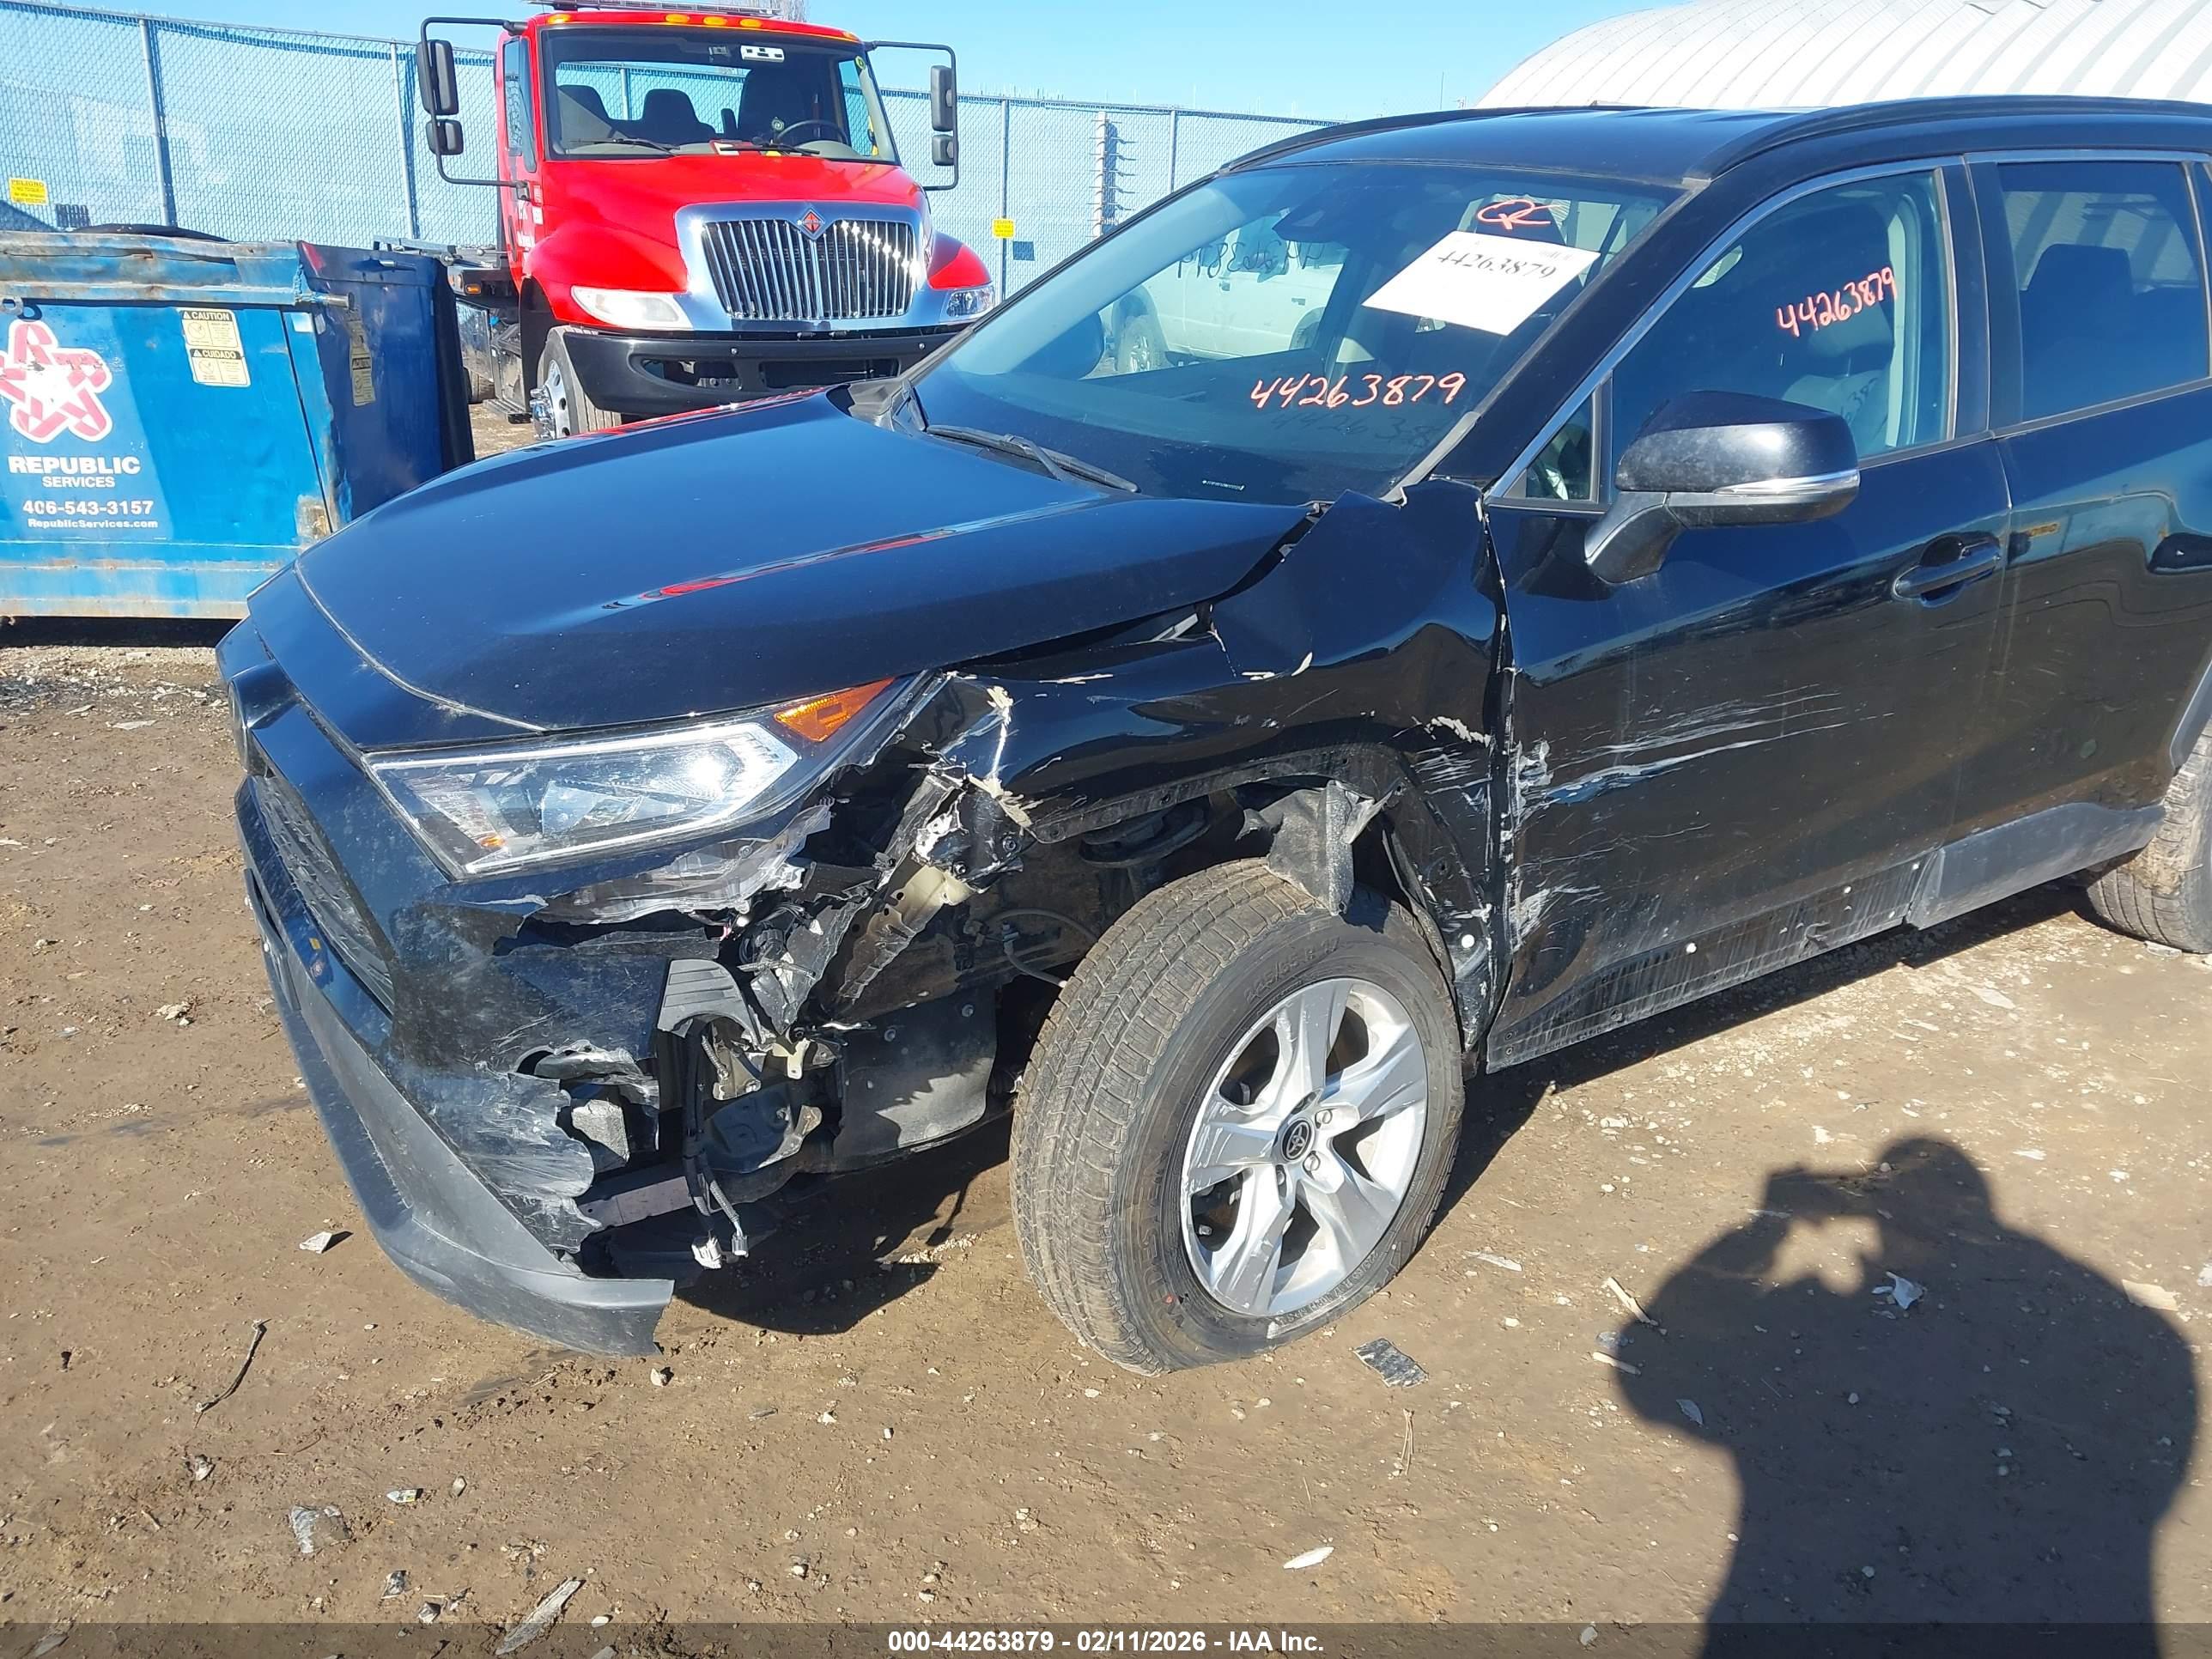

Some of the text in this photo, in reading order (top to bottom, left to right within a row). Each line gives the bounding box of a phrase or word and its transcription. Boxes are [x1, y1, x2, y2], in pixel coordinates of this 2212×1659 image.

[1436, 250, 1558, 279] 44263879
[1777, 267, 1898, 337] 44263879
[191, 312, 230, 320] CAUTION
[202, 349, 237, 358] CUIDADO
[1250, 373, 1467, 409] 44263879
[8, 456, 142, 474] REPUBLIC
[42, 477, 116, 488] SERVICES
[23, 501, 154, 515] 406-543-3157
[27, 519, 159, 529] RepublicServices.com
